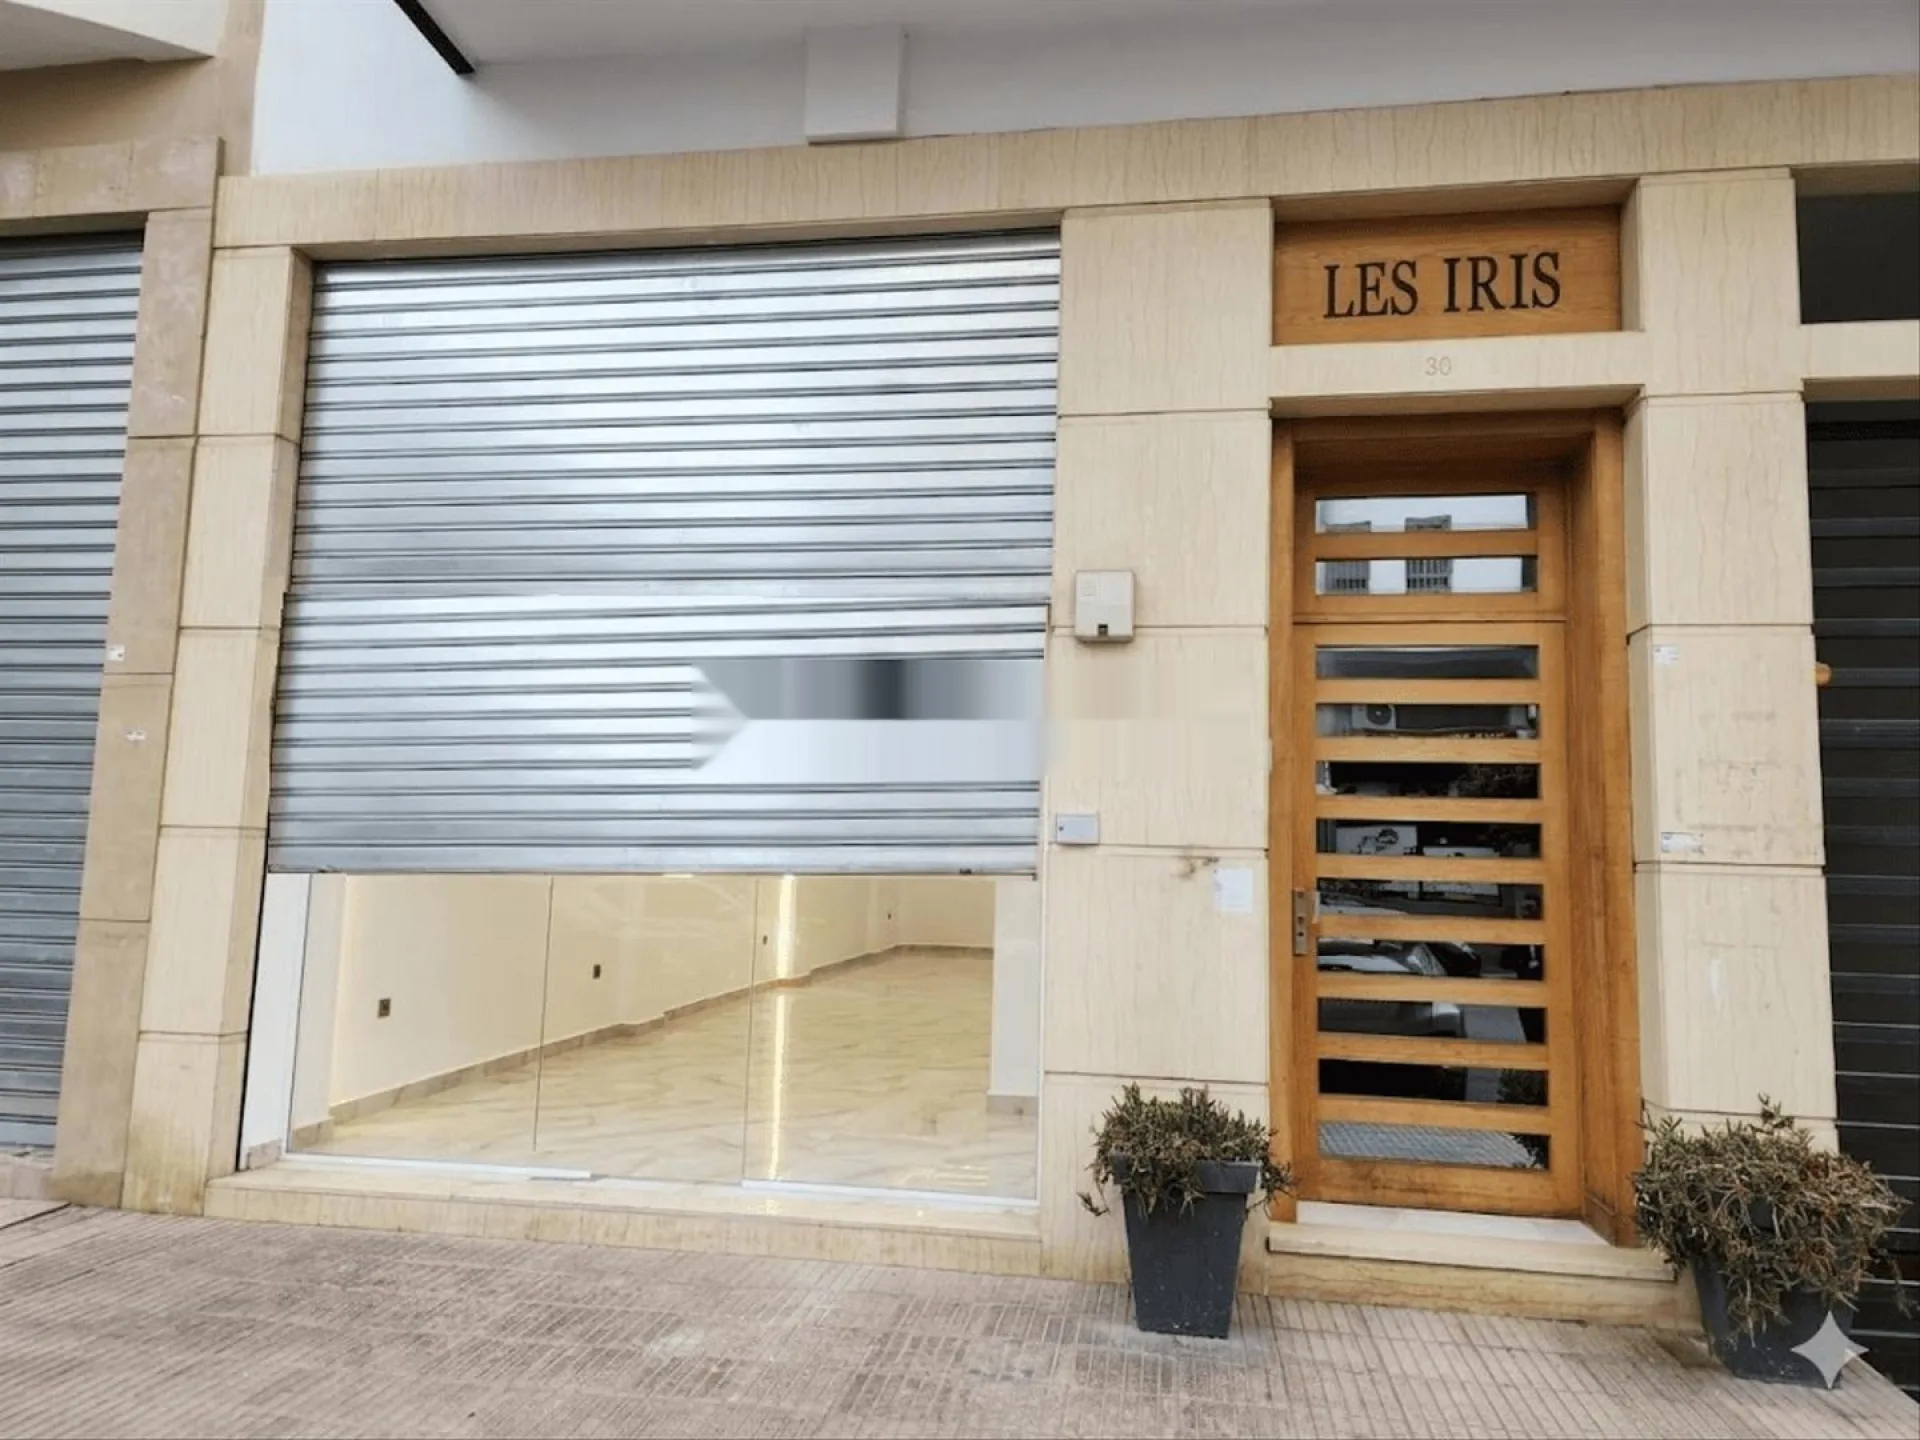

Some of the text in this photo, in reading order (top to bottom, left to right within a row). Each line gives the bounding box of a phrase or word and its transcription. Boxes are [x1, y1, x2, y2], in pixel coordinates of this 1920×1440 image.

[1323, 251, 1561, 318] LES IRIS
[1425, 356, 1451, 376] 30
